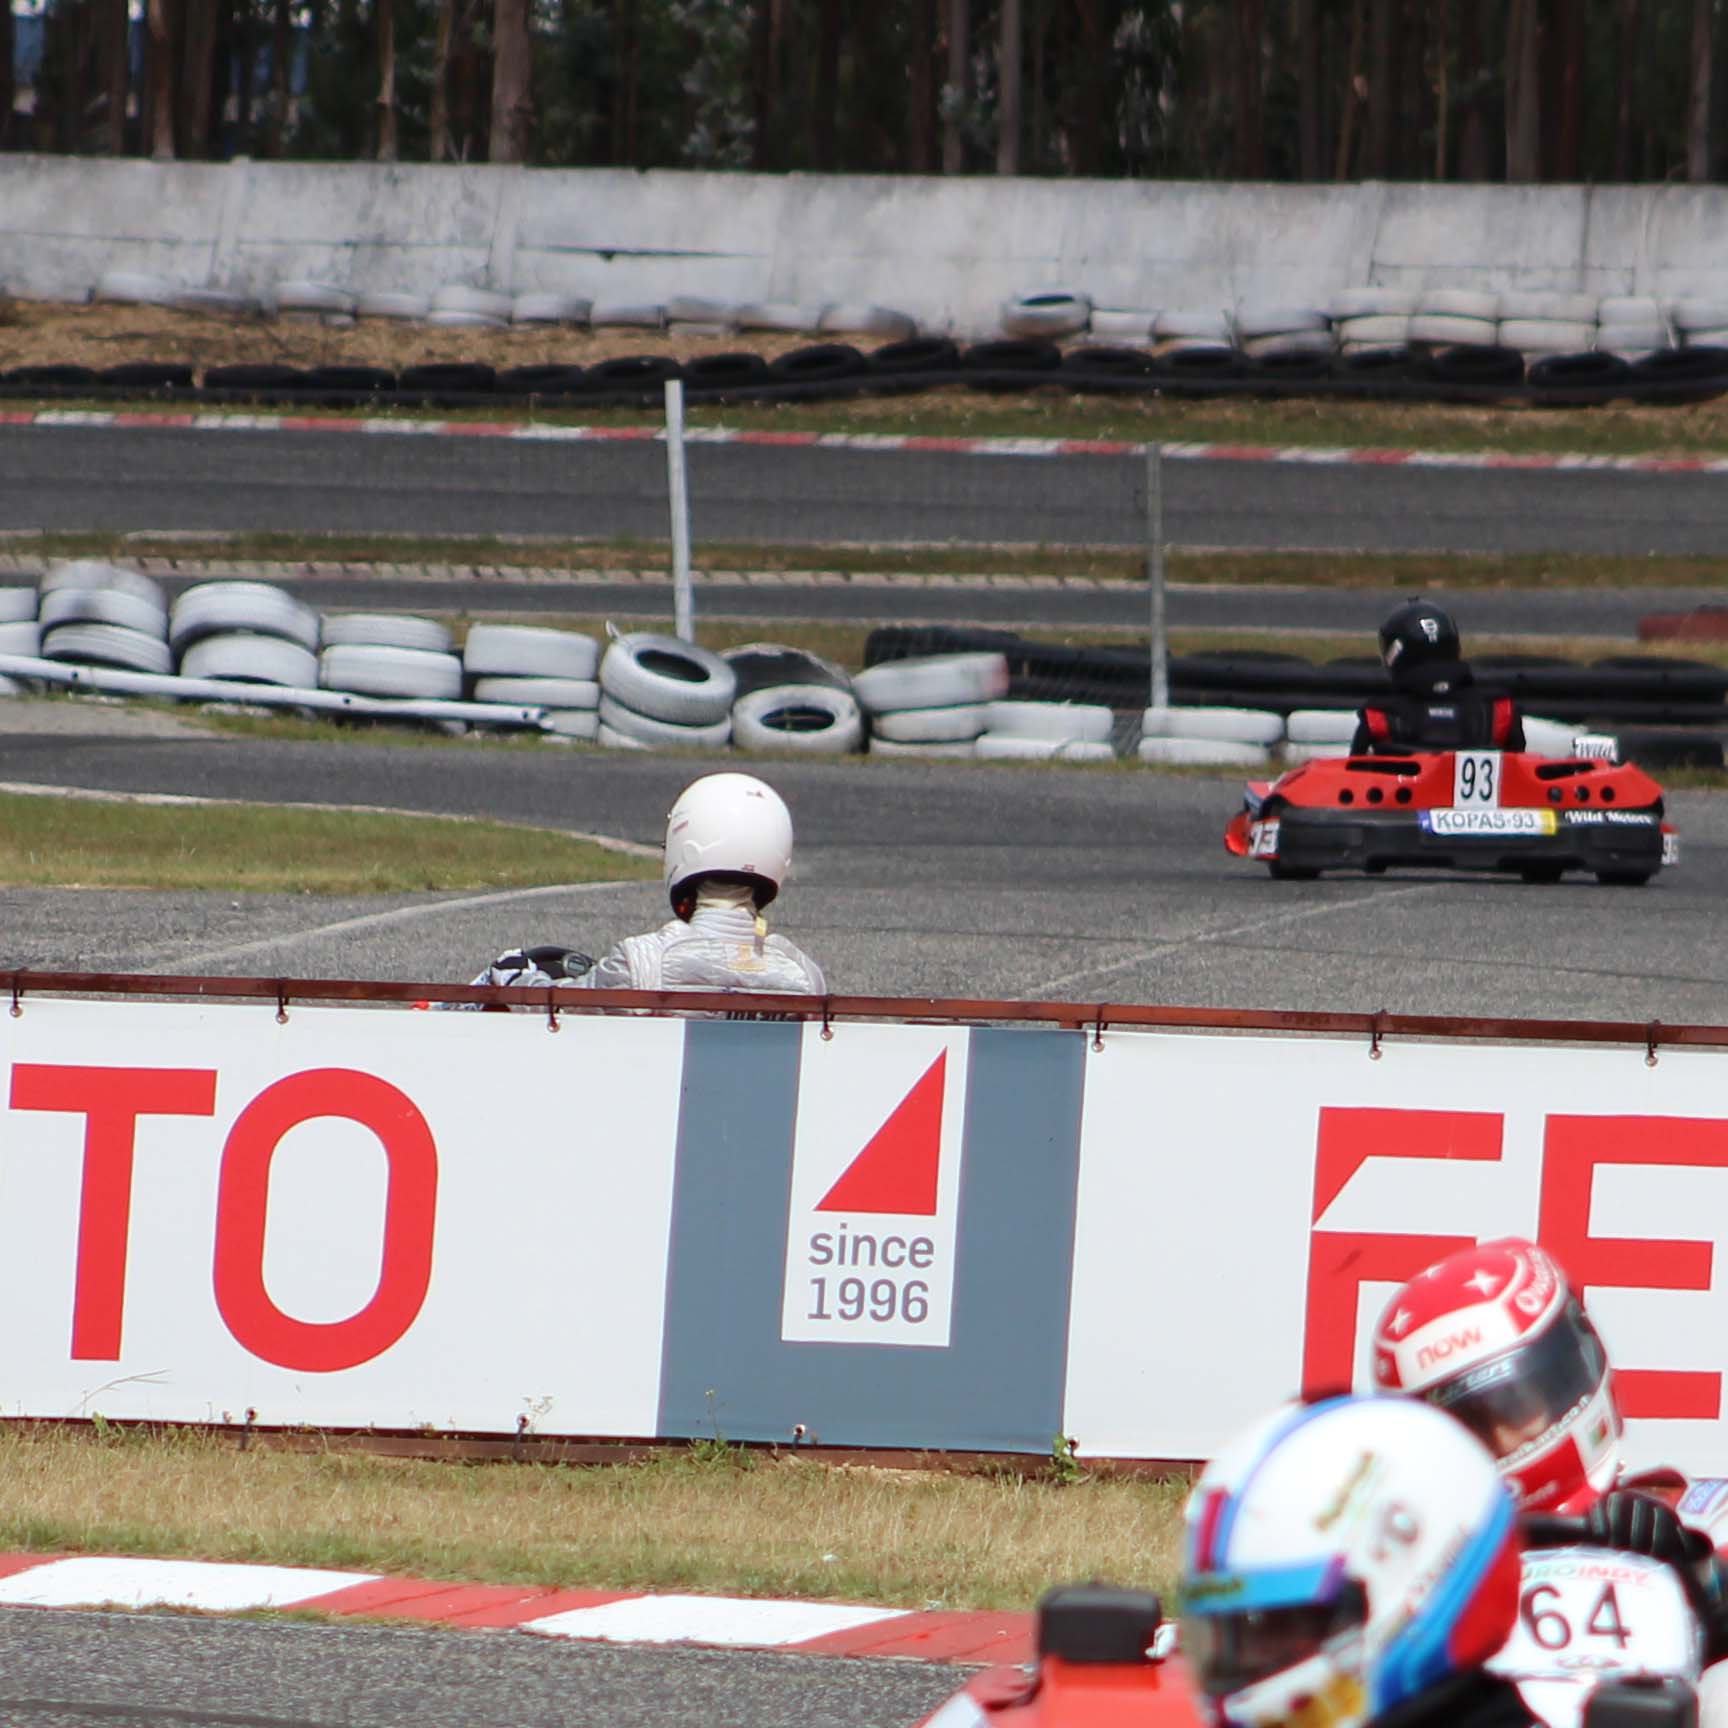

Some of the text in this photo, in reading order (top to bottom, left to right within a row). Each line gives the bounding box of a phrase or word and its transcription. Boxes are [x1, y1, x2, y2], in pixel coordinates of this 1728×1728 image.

[1460, 757, 1493, 801] 93
[1564, 810, 1603, 825] Wild
[807, 1222, 934, 1268] since
[806, 1277, 930, 1325] 1996
[1520, 1581, 1633, 1652] 64
